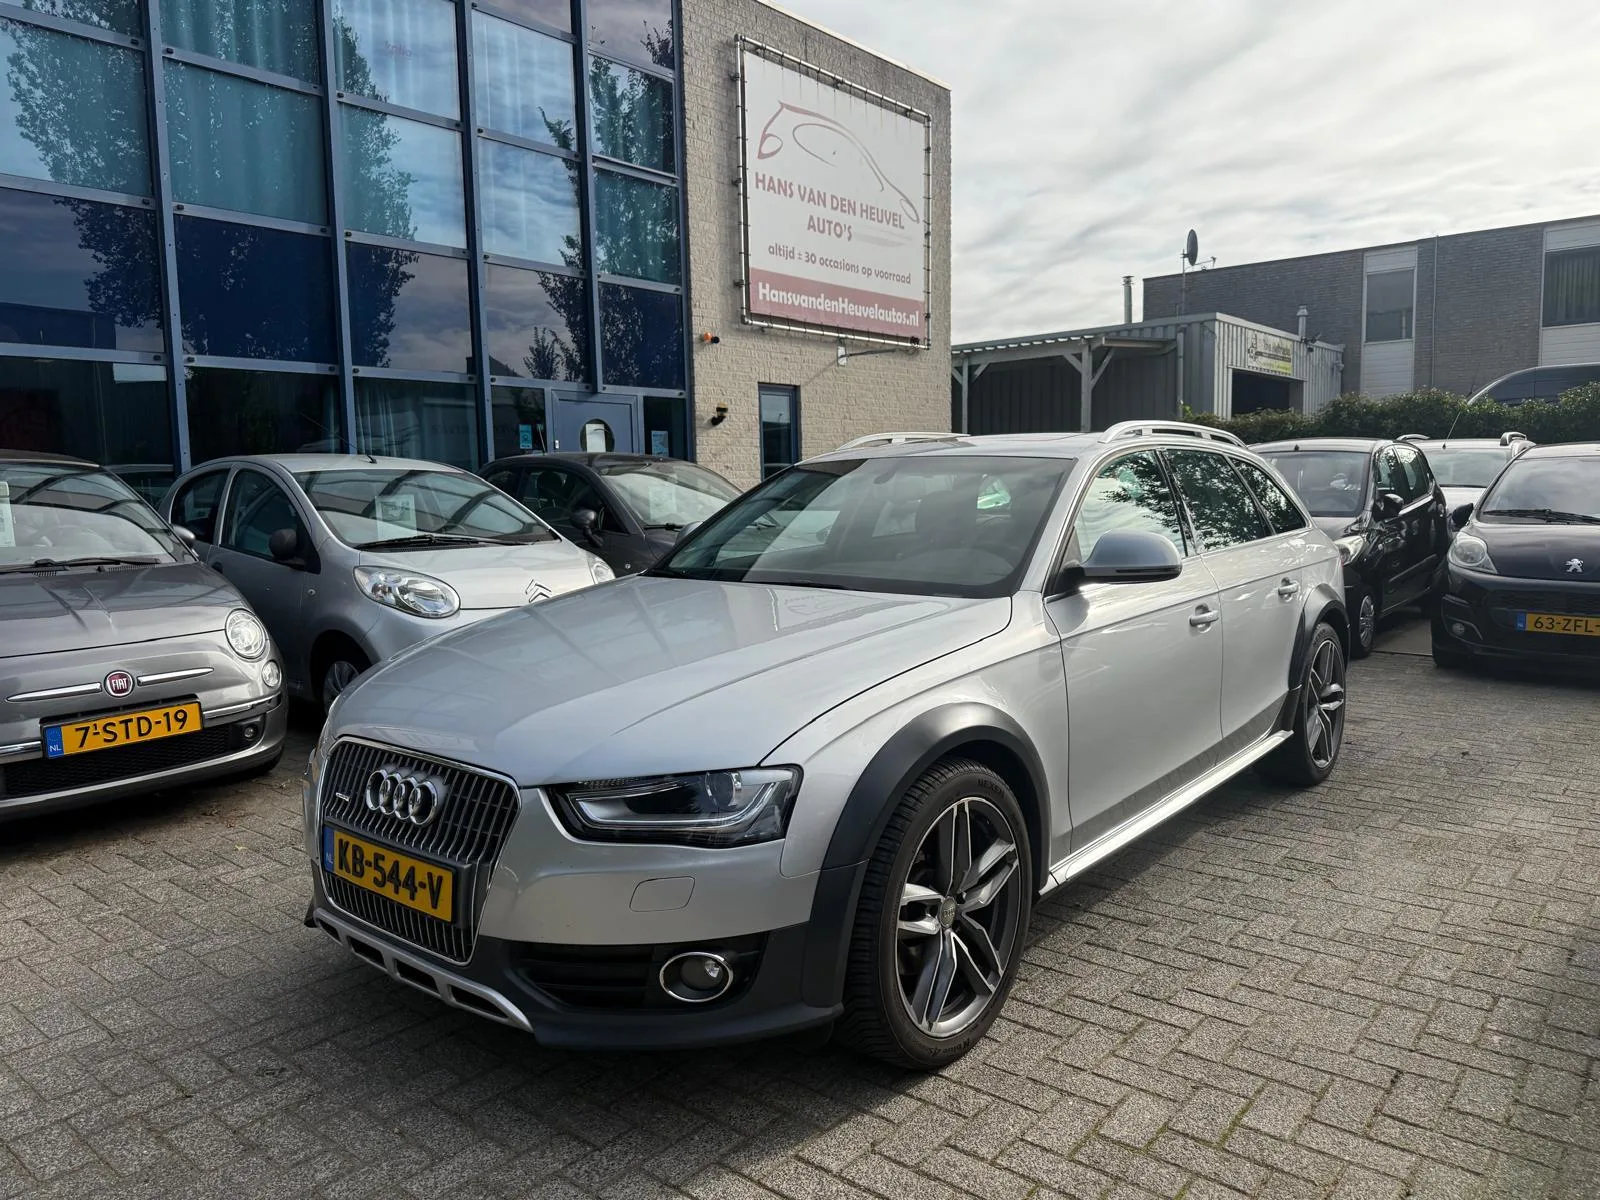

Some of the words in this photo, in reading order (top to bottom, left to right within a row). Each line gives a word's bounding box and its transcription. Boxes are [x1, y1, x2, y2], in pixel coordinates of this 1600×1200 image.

[755, 171, 794, 199] HANS
[797, 184, 827, 209] VAN
[830, 195, 857, 217] DEN
[859, 202, 905, 230] HEUVEL
[807, 214, 853, 242] AUTO'S
[768, 243, 795, 261] altijd
[804, 251, 817, 265] 30
[819, 257, 860, 275] occasions
[861, 265, 873, 279] op
[874, 269, 912, 285] voorraad
[758, 282, 919, 328] HansvandenHeuvelautos.nl
[1534, 616, 1600, 633] 63-ZFL-
[112, 677, 128, 691] FIAT
[50, 744, 62, 752] NL
[338, 838, 443, 910] KB-544-V
